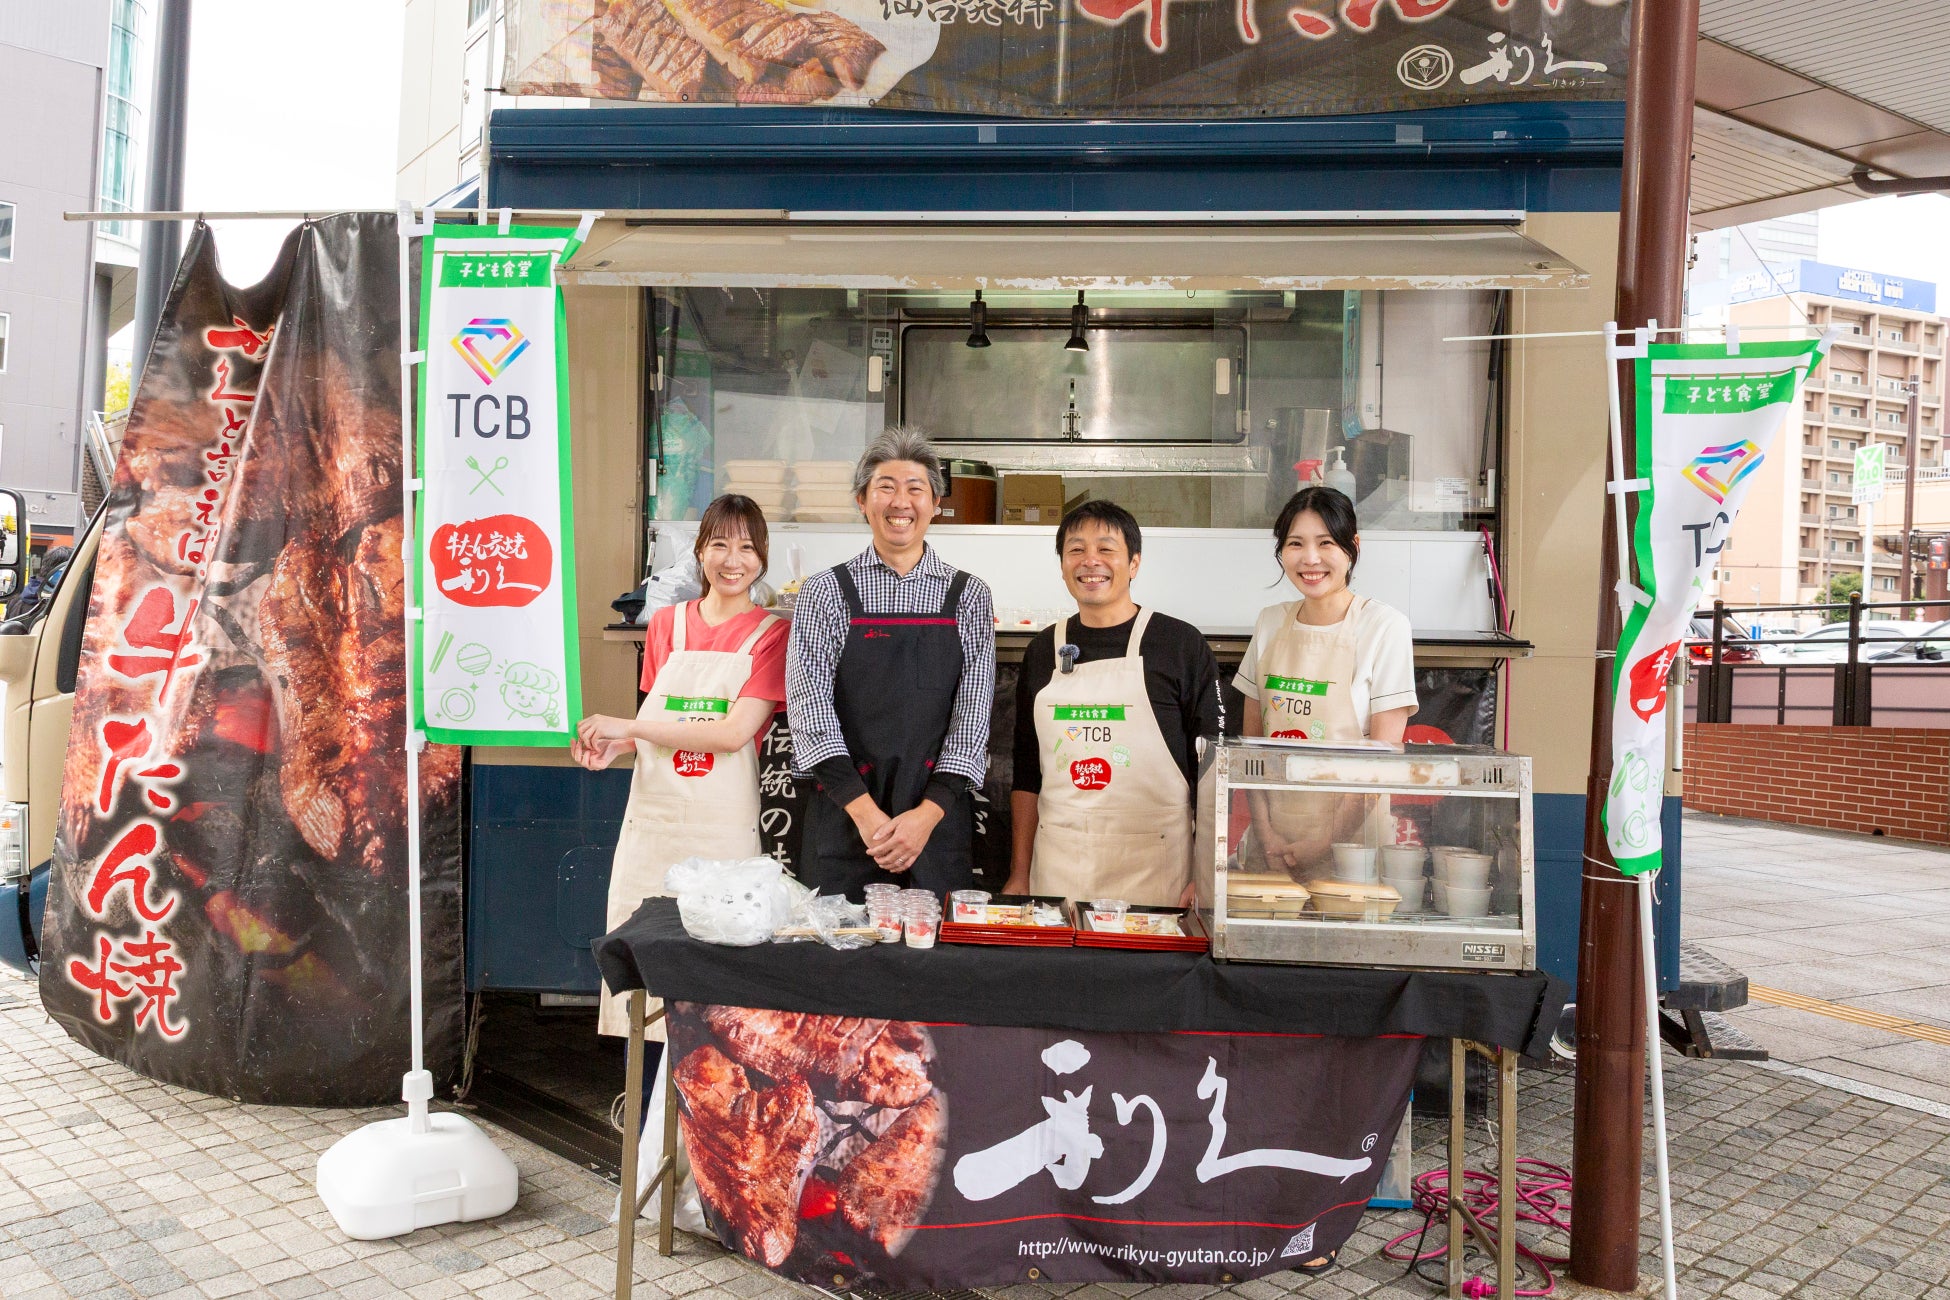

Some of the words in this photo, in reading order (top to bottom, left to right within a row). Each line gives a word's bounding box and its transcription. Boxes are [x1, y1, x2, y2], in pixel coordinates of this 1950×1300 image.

[459, 260, 532, 278] 子ども食堂
[1686, 381, 1774, 404] 子ども食堂
[446, 393, 531, 440] TCB
[445, 531, 528, 560] 牛たん炭焼
[441, 557, 542, 594] 利久
[1278, 681, 1314, 693] 子ども食堂
[1070, 709, 1109, 719] 子ども食堂
[1286, 697, 1312, 715] TCB
[1082, 726, 1112, 742] TCB
[70, 586, 205, 1037] 牛たん焼
[1464, 944, 1504, 955] NISSEI
[1018, 1237, 1275, 1267] http://www.rikyu-gyutan.co.jp/
